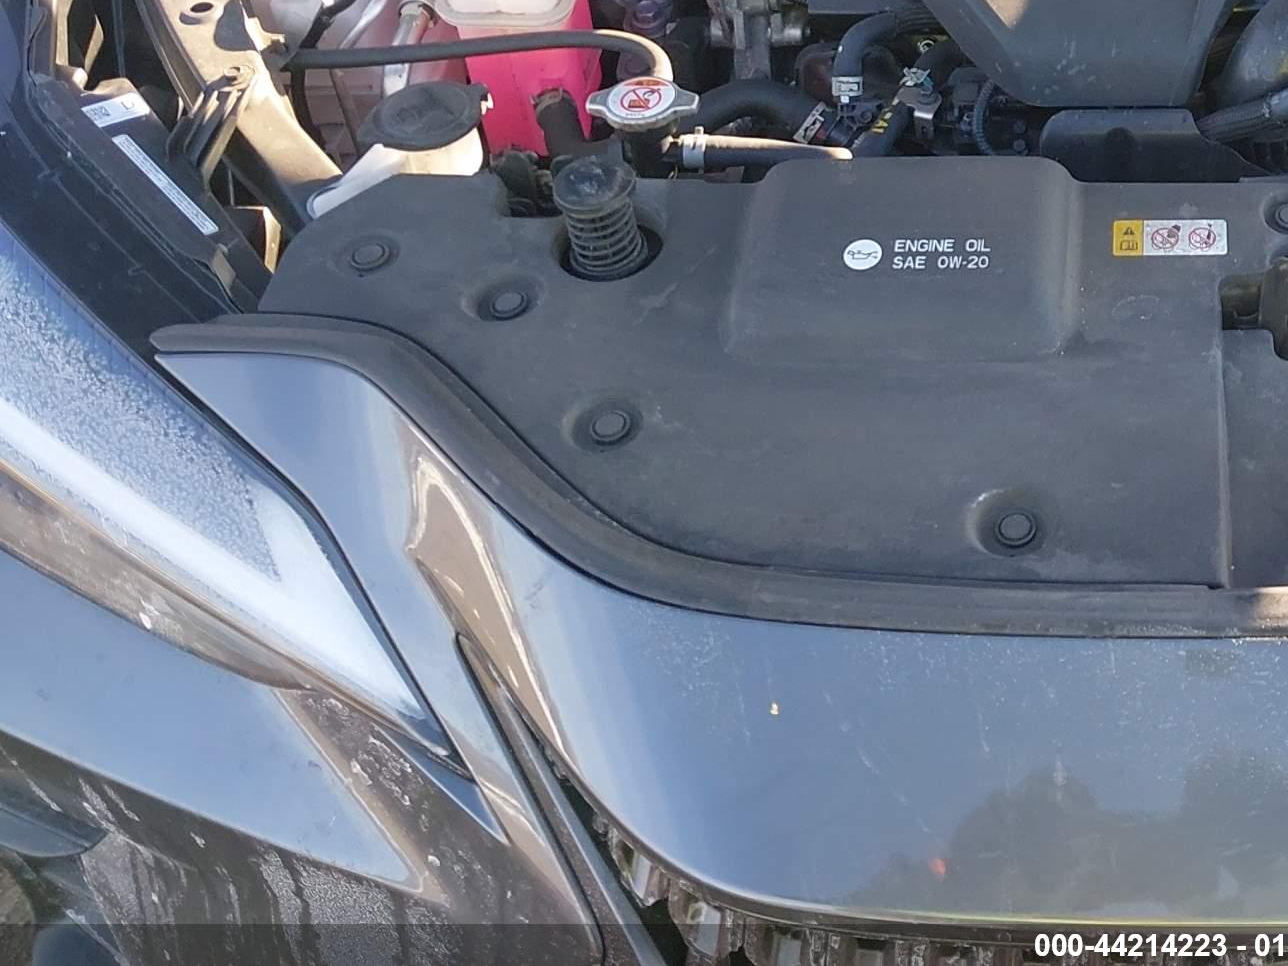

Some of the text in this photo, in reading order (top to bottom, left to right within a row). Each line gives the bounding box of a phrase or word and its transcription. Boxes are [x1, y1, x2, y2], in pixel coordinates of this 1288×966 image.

[894, 239, 991, 252] ENGINE OIL
[892, 256, 989, 269] SAE 0W-20
